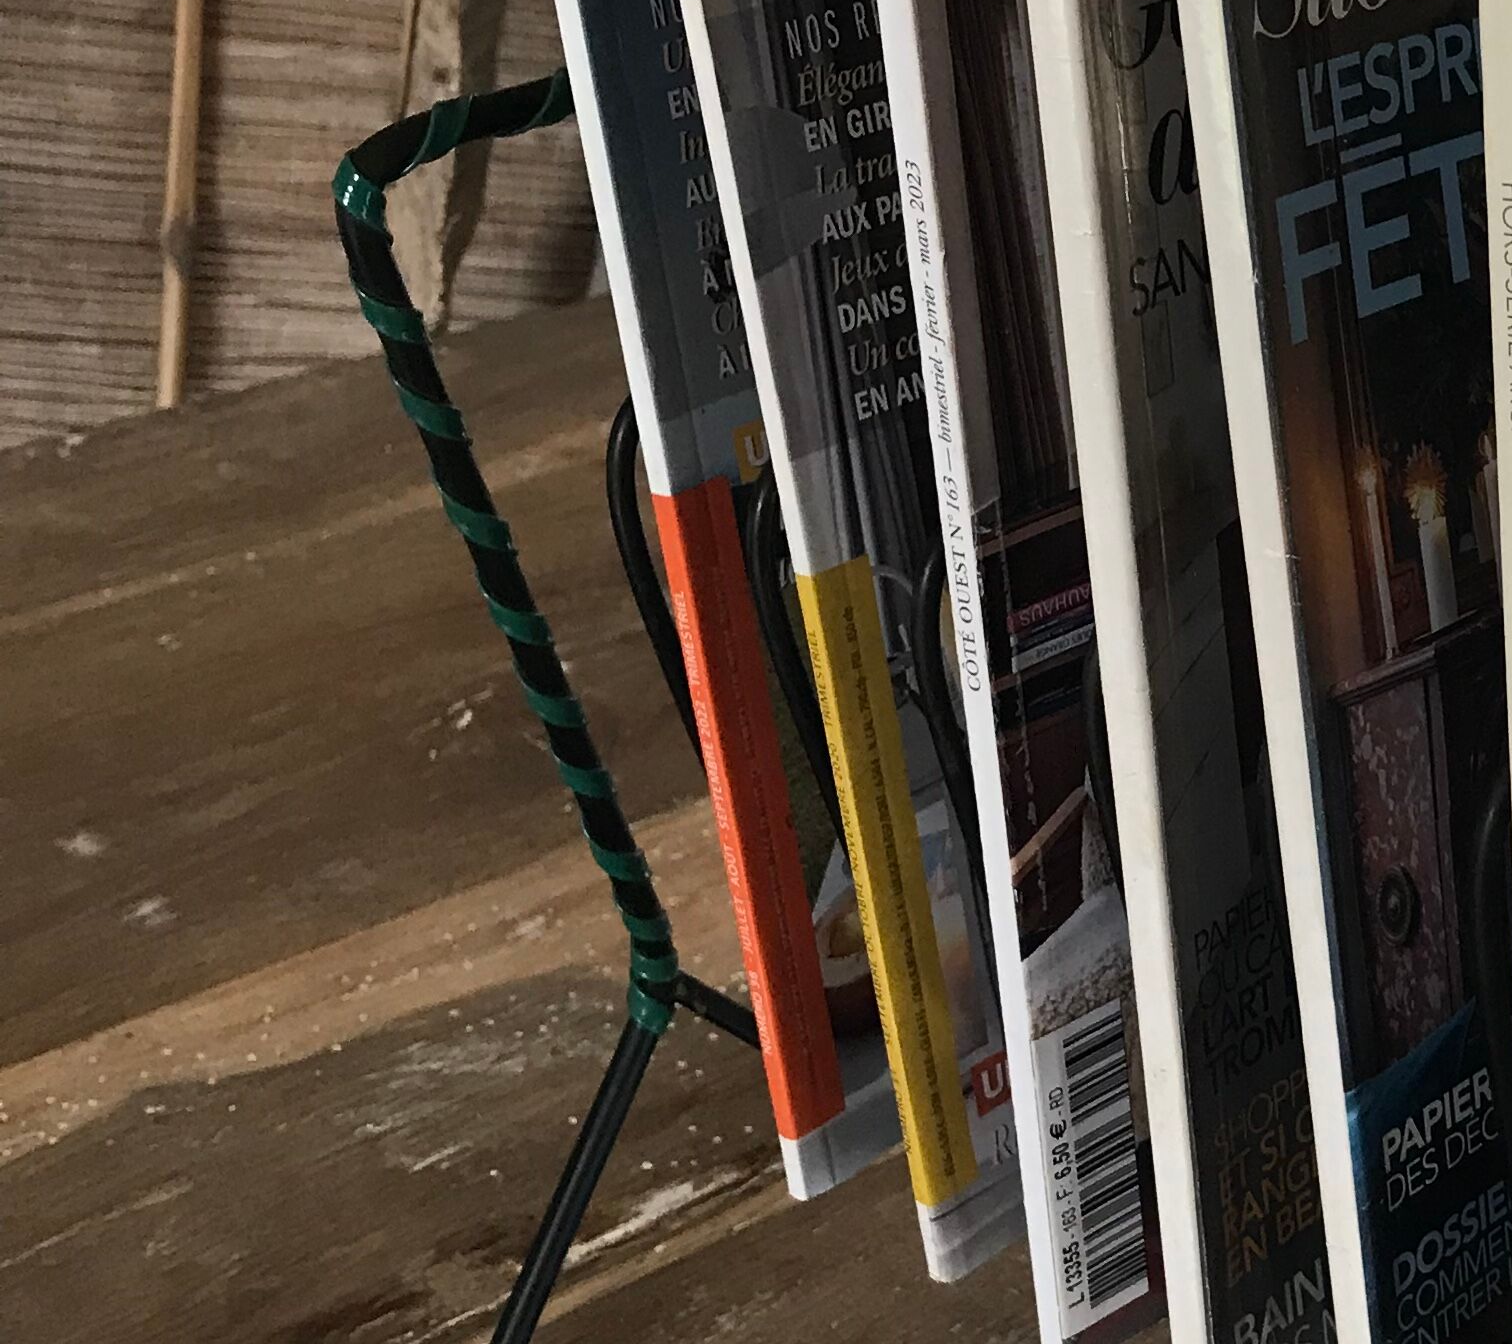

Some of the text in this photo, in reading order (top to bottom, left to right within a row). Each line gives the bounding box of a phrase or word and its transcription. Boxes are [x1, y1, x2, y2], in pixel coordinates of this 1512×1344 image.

[785, 9, 840, 60] NOS
[798, 59, 886, 107] Élégan
[804, 99, 894, 153] EN GIR
[855, 151, 899, 187] tra
[821, 191, 903, 245] AUX PA
[831, 248, 890, 296] Jeux
[837, 284, 907, 334] DANS
[854, 383, 891, 422] EN
[905, 159, 981, 693] CÔTÉ OUEST N° 163 bimestriel février mars 2023
[673, 590, 701, 687] TRIMESTRIEL
[695, 704, 712, 739] 2022
[700, 740, 731, 831] SEPTEMBRE
[1207, 1005, 1296, 1096] TROM
[1386, 1146, 1440, 1213] DES
[1393, 1179, 1509, 1297] DOSSIE
[1062, 1241, 1082, 1291] 13355
